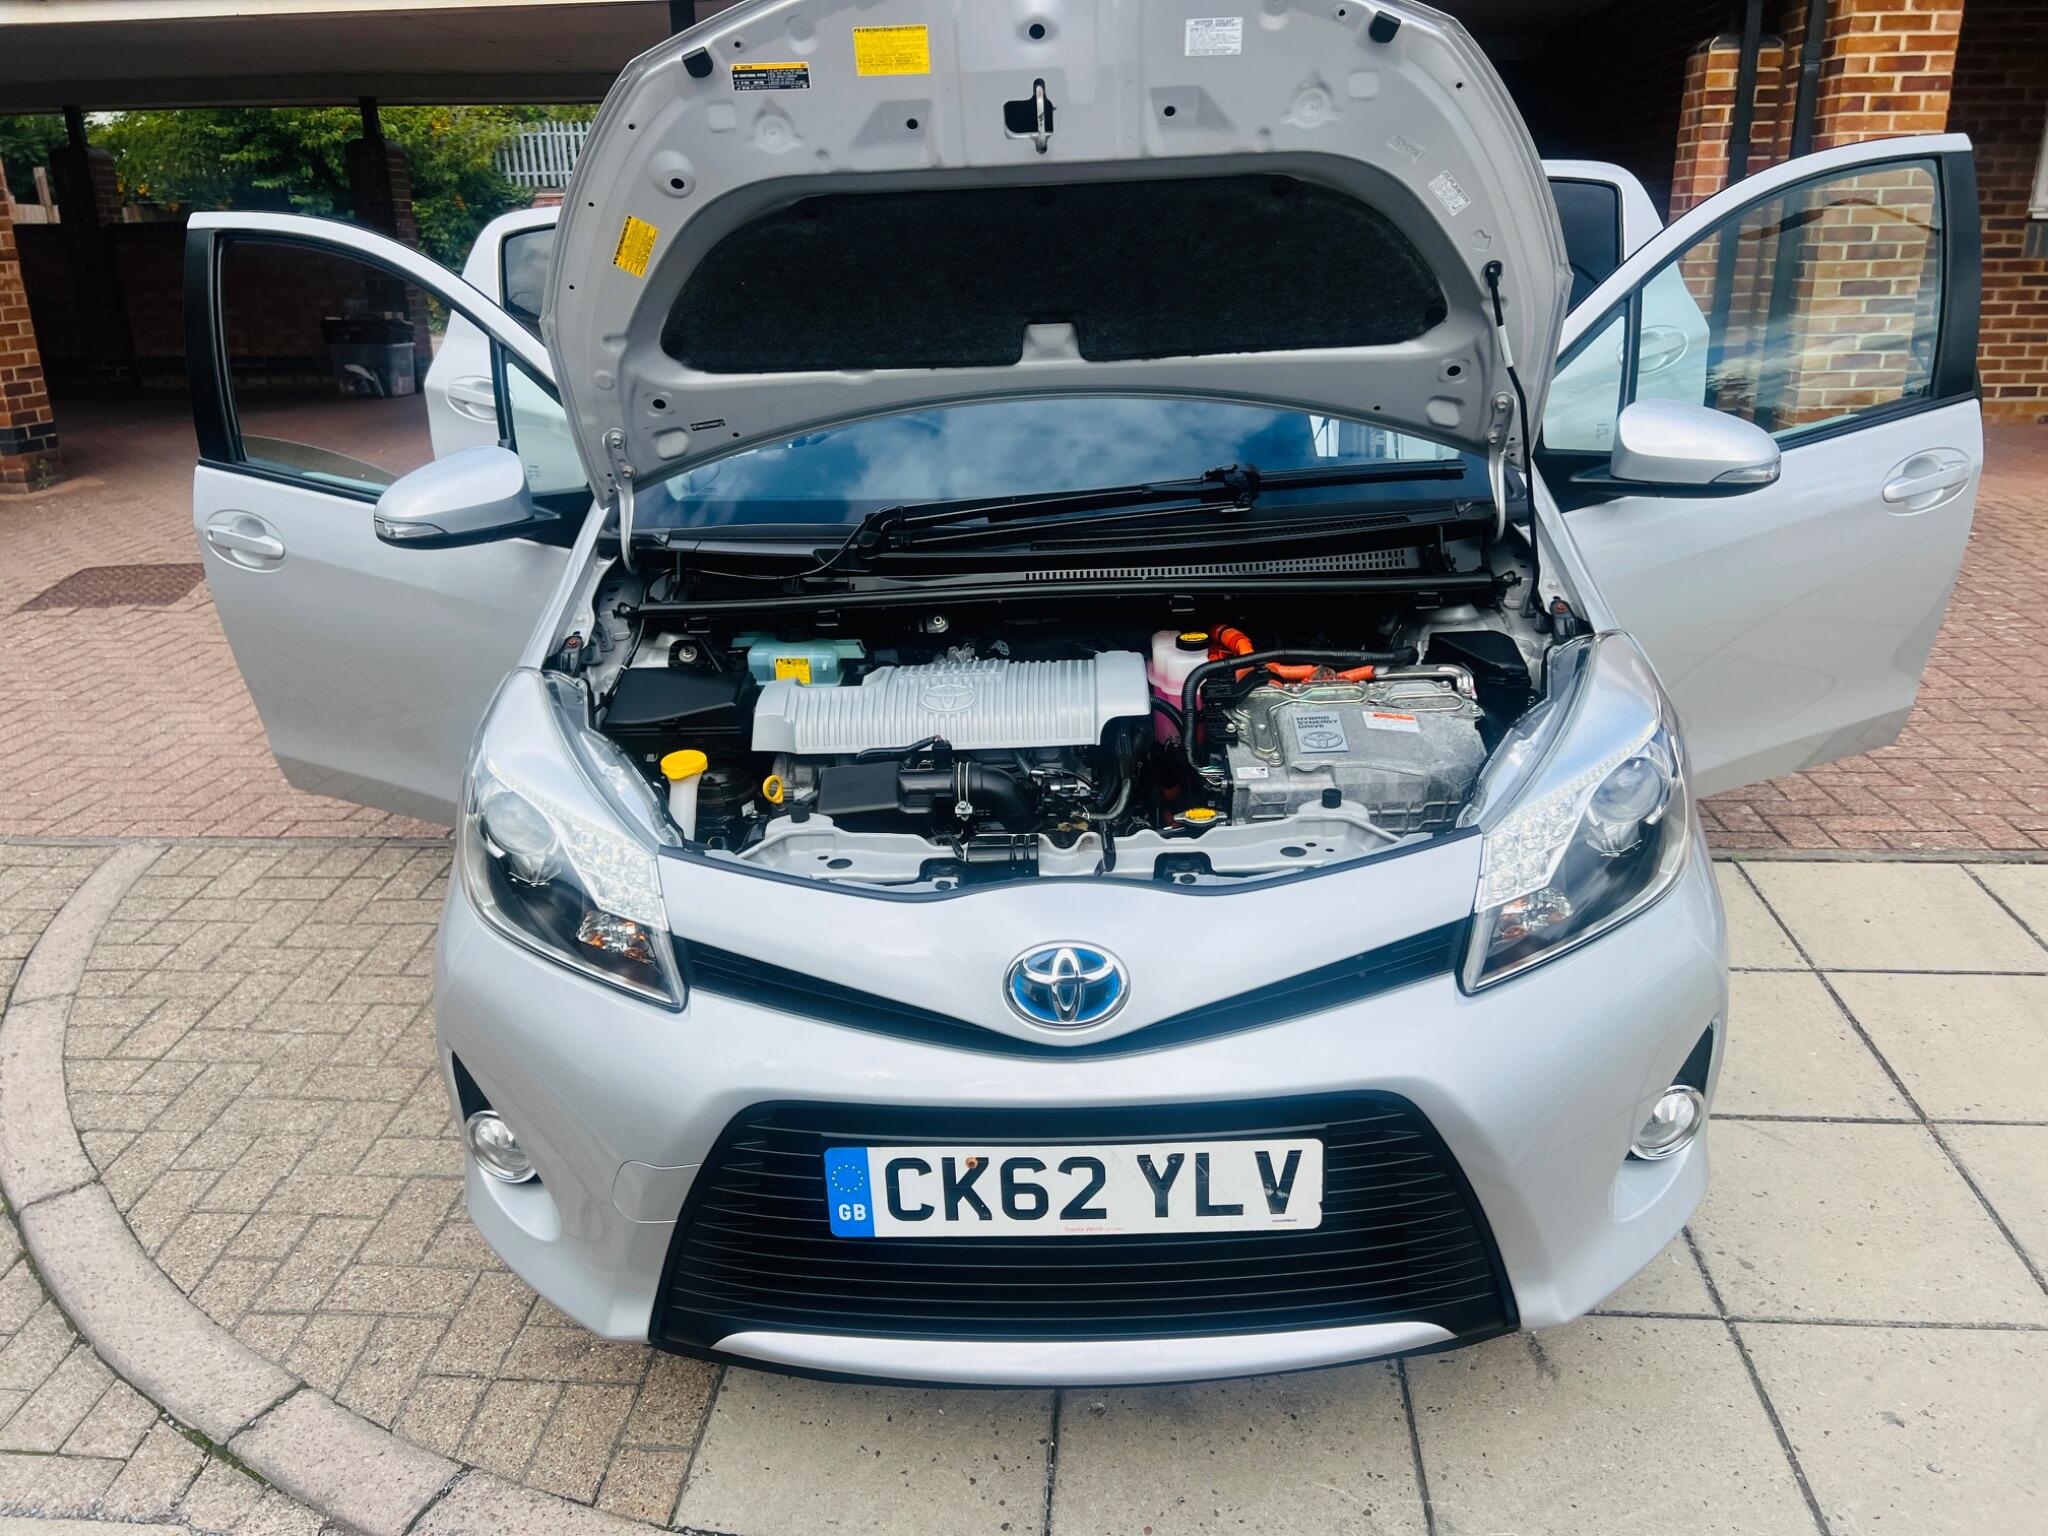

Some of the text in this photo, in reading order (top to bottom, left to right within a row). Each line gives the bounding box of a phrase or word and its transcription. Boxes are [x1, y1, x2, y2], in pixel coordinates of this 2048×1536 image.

[885, 1150, 1303, 1222] CK62 YLV
[838, 1203, 867, 1222] GB
